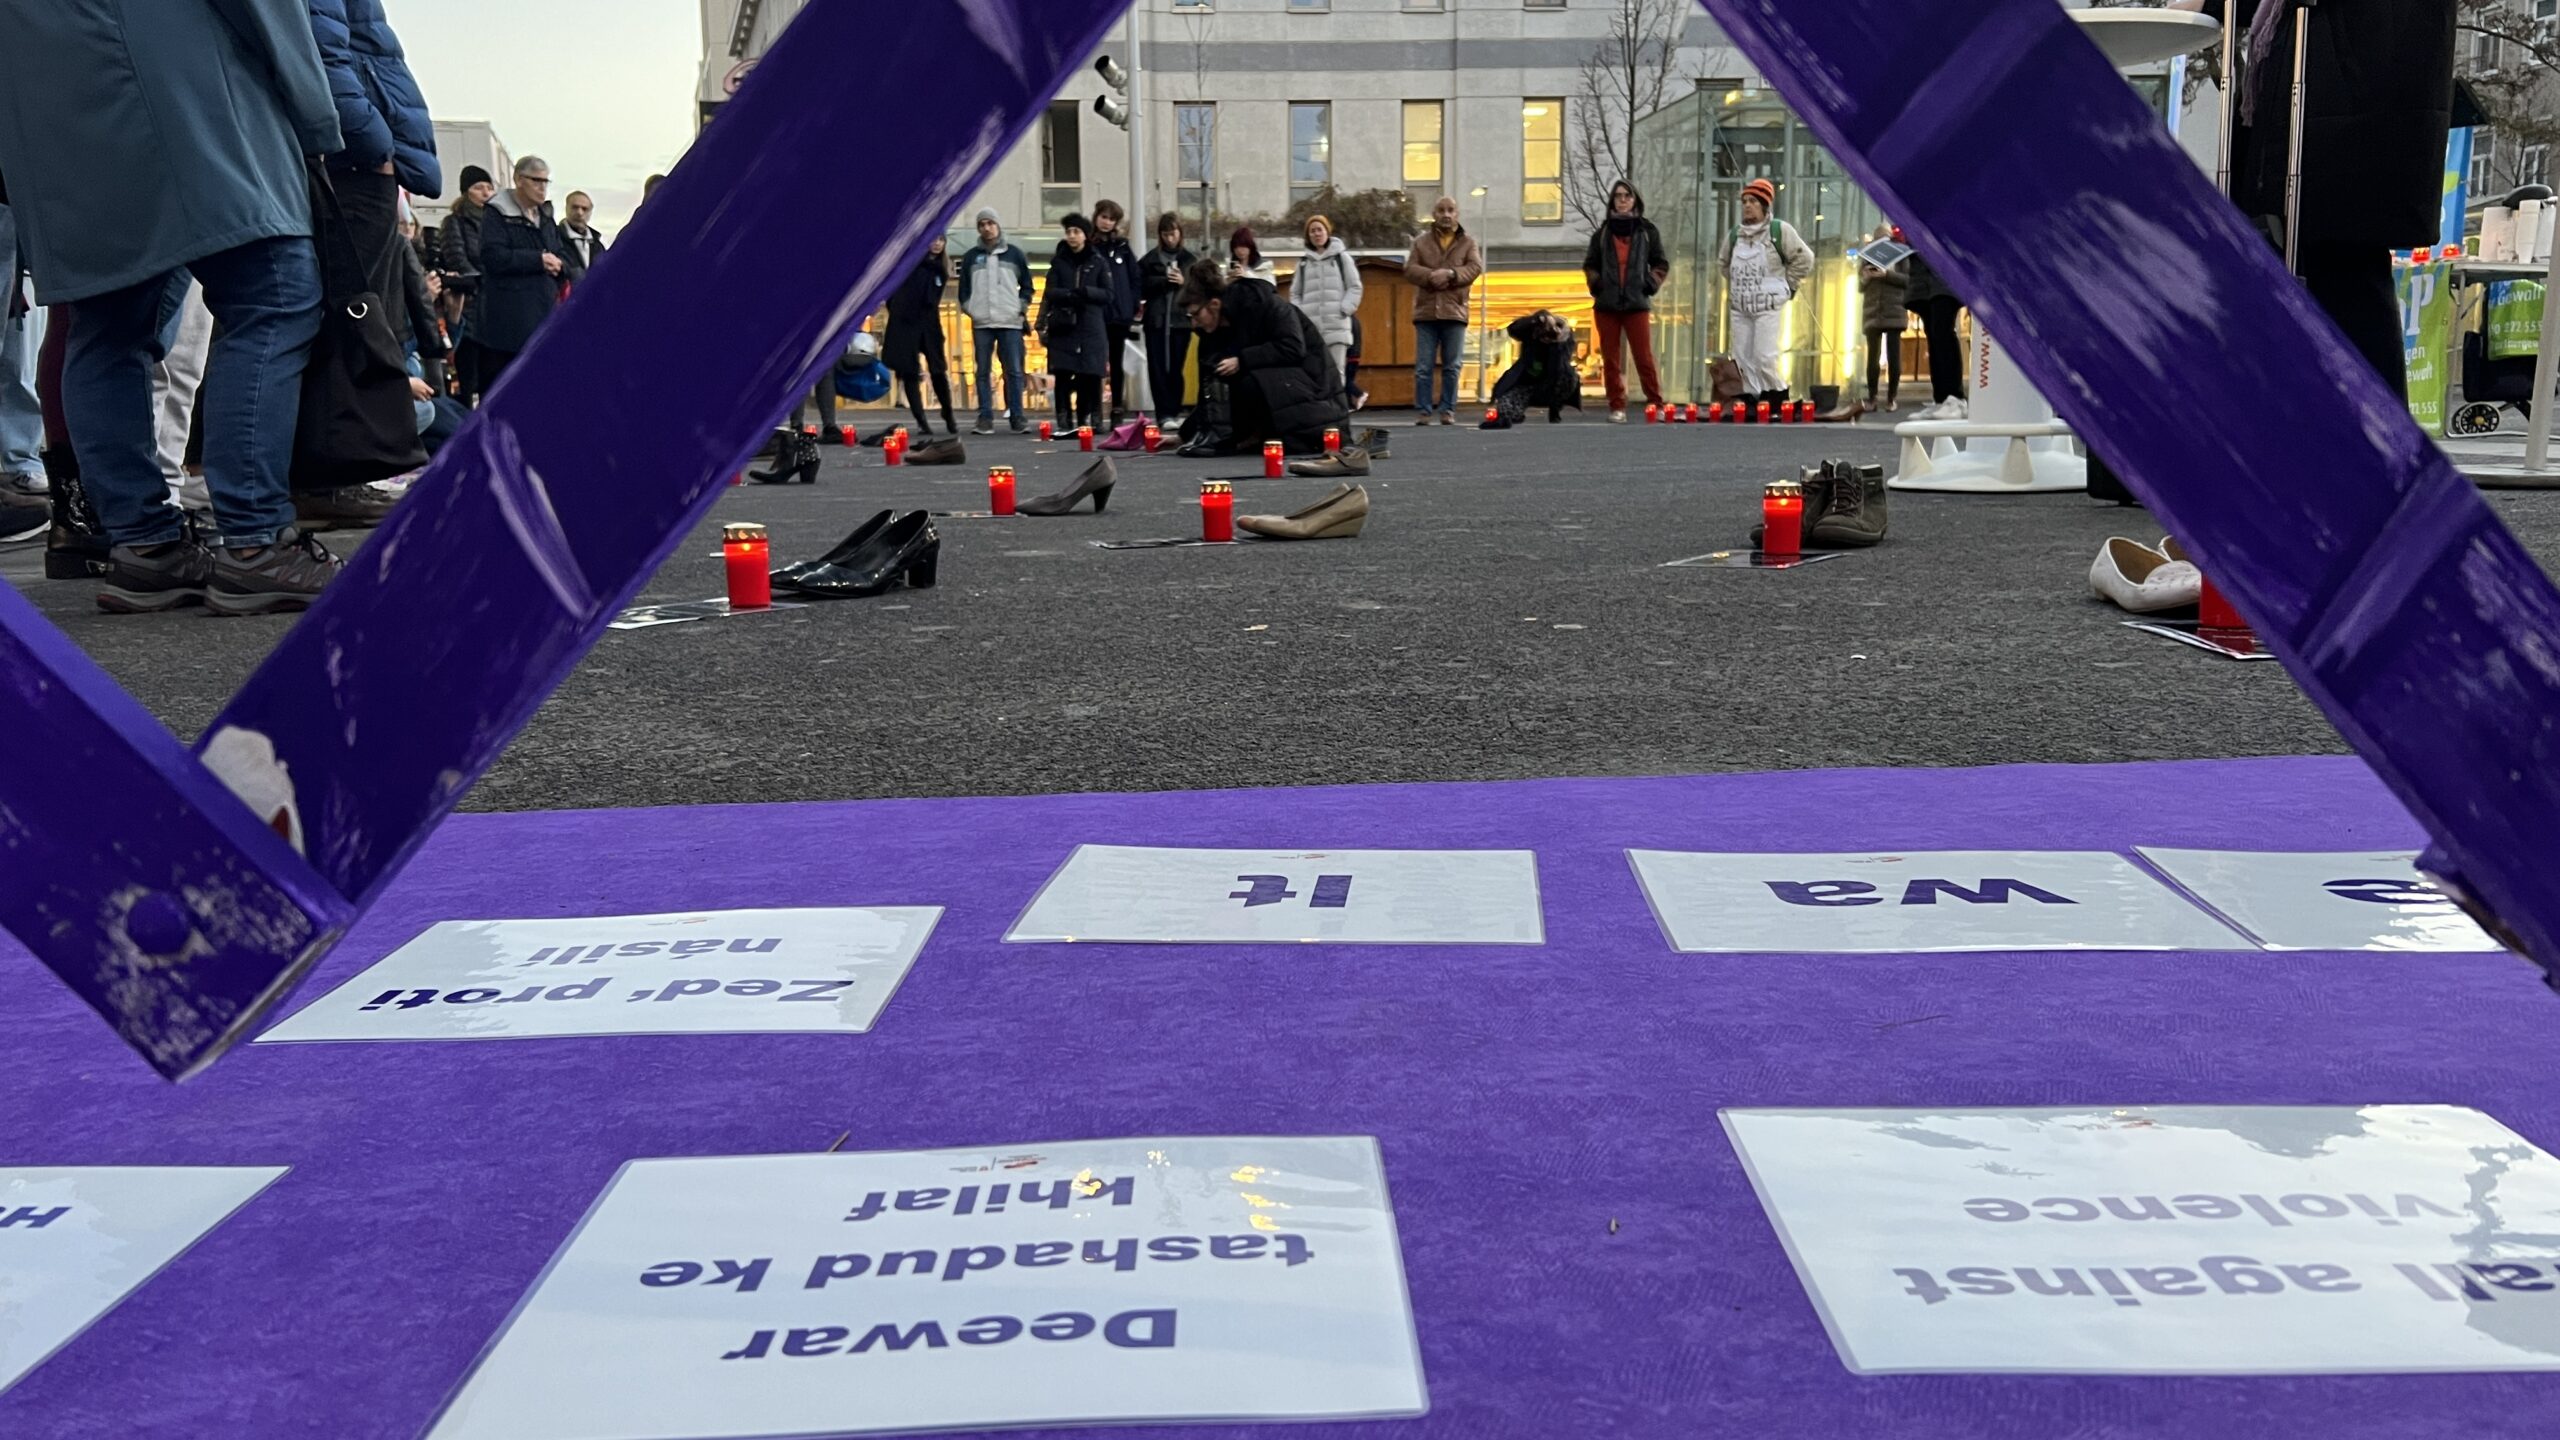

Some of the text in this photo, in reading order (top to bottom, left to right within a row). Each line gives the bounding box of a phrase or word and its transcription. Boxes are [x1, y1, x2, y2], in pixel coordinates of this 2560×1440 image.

[2405, 346, 2425, 366] gen
[2406, 361, 2433, 383] ewalt
[1763, 878, 2080, 906] wa
[516, 936, 784, 968] násilí
[358, 976, 614, 1011] proti
[842, 1176, 1136, 1222] khilaf
[1963, 1193, 2466, 1227] violence
[639, 1233, 1315, 1292] tashadud ke
[1892, 1255, 2363, 1306] against
[719, 1307, 1178, 1361] Deewar
